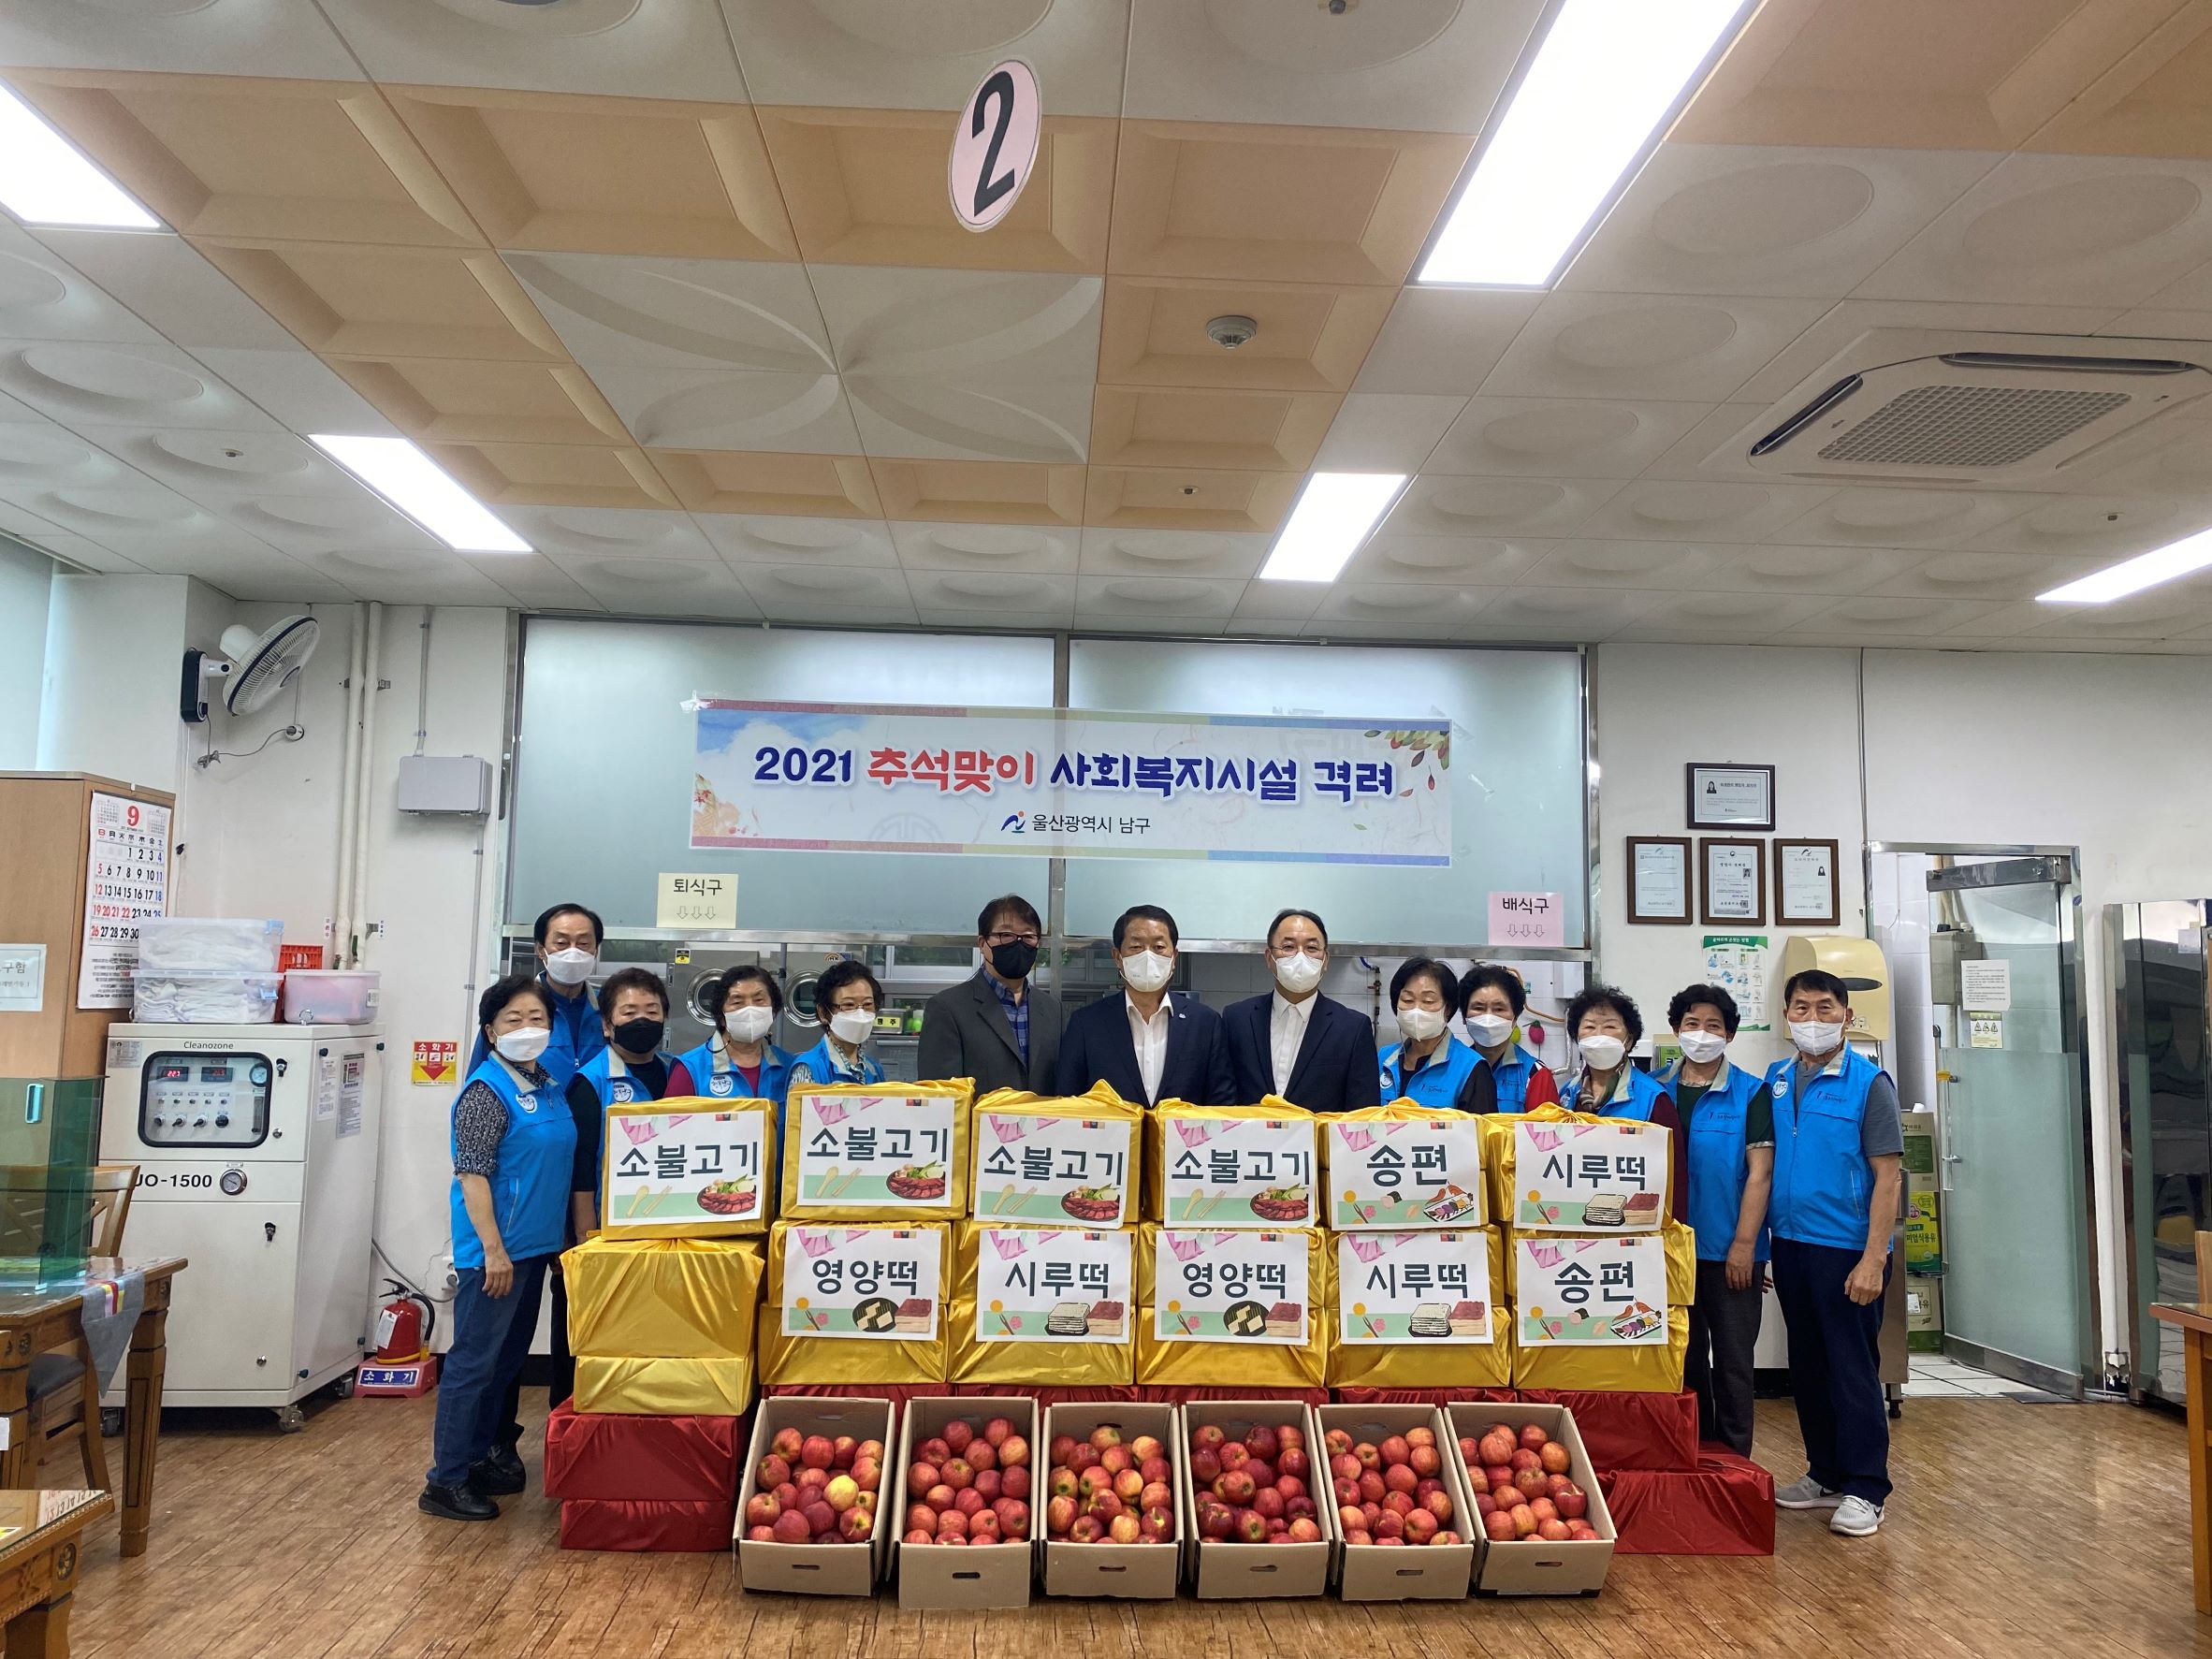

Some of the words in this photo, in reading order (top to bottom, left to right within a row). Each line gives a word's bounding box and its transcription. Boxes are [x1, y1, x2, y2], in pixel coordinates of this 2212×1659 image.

[972, 70, 1015, 217] 2
[754, 746, 852, 783] 2021
[866, 747, 1034, 793] 추석맞이
[1050, 751, 1298, 801] 사회복지시설
[1313, 760, 1394, 803] 격려
[127, 805, 139, 826] 9
[1032, 814, 1113, 834] 울산광역시
[1119, 816, 1151, 836] 남구
[97, 864, 102, 874] 5
[107, 865, 111, 875] 6
[116, 866, 122, 876] 7
[126, 867, 131, 878] 8
[137, 868, 142, 879] 9
[146, 869, 154, 880] 10
[156, 871, 163, 881] 11
[128, 847, 132, 857] 1
[138, 849, 143, 859] 2
[149, 851, 153, 861] 3
[157, 851, 162, 862] 4
[95, 883, 103, 895] 12
[104, 885, 112, 896] 13
[114, 886, 122, 897] 14
[124, 887, 132, 898] 15
[134, 888, 142, 899] 16
[145, 889, 153, 900] 17
[154, 890, 162, 901] 18
[673, 879, 722, 896] 퇴식구
[1502, 897, 1550, 914] 배식구
[93, 905, 101, 915] 19
[102, 906, 109, 917] 20
[111, 907, 120, 917] 21
[122, 907, 130, 918] 22
[132, 908, 140, 919] 23
[91, 925, 99, 937] 26
[100, 926, 109, 937] 27
[109, 927, 118, 938] 28
[120, 927, 129, 939] 29
[130, 928, 139, 939] 30
[183, 1041, 234, 1050] Cleanozone
[616, 1141, 759, 1181] 소불고기
[807, 1127, 949, 1164] 소불고기
[983, 1144, 1124, 1186] 소불고기
[1171, 1149, 1311, 1186] 소불고기
[1366, 1143, 1448, 1187] 송편
[1543, 1153, 1647, 1191] 시루떡
[811, 1259, 919, 1296] 영양떡
[1004, 1260, 1111, 1297] 시루떡
[1182, 1262, 1288, 1300] 영양떡
[1366, 1263, 1468, 1300] 시루떡
[1554, 1259, 1636, 1304] 송편
